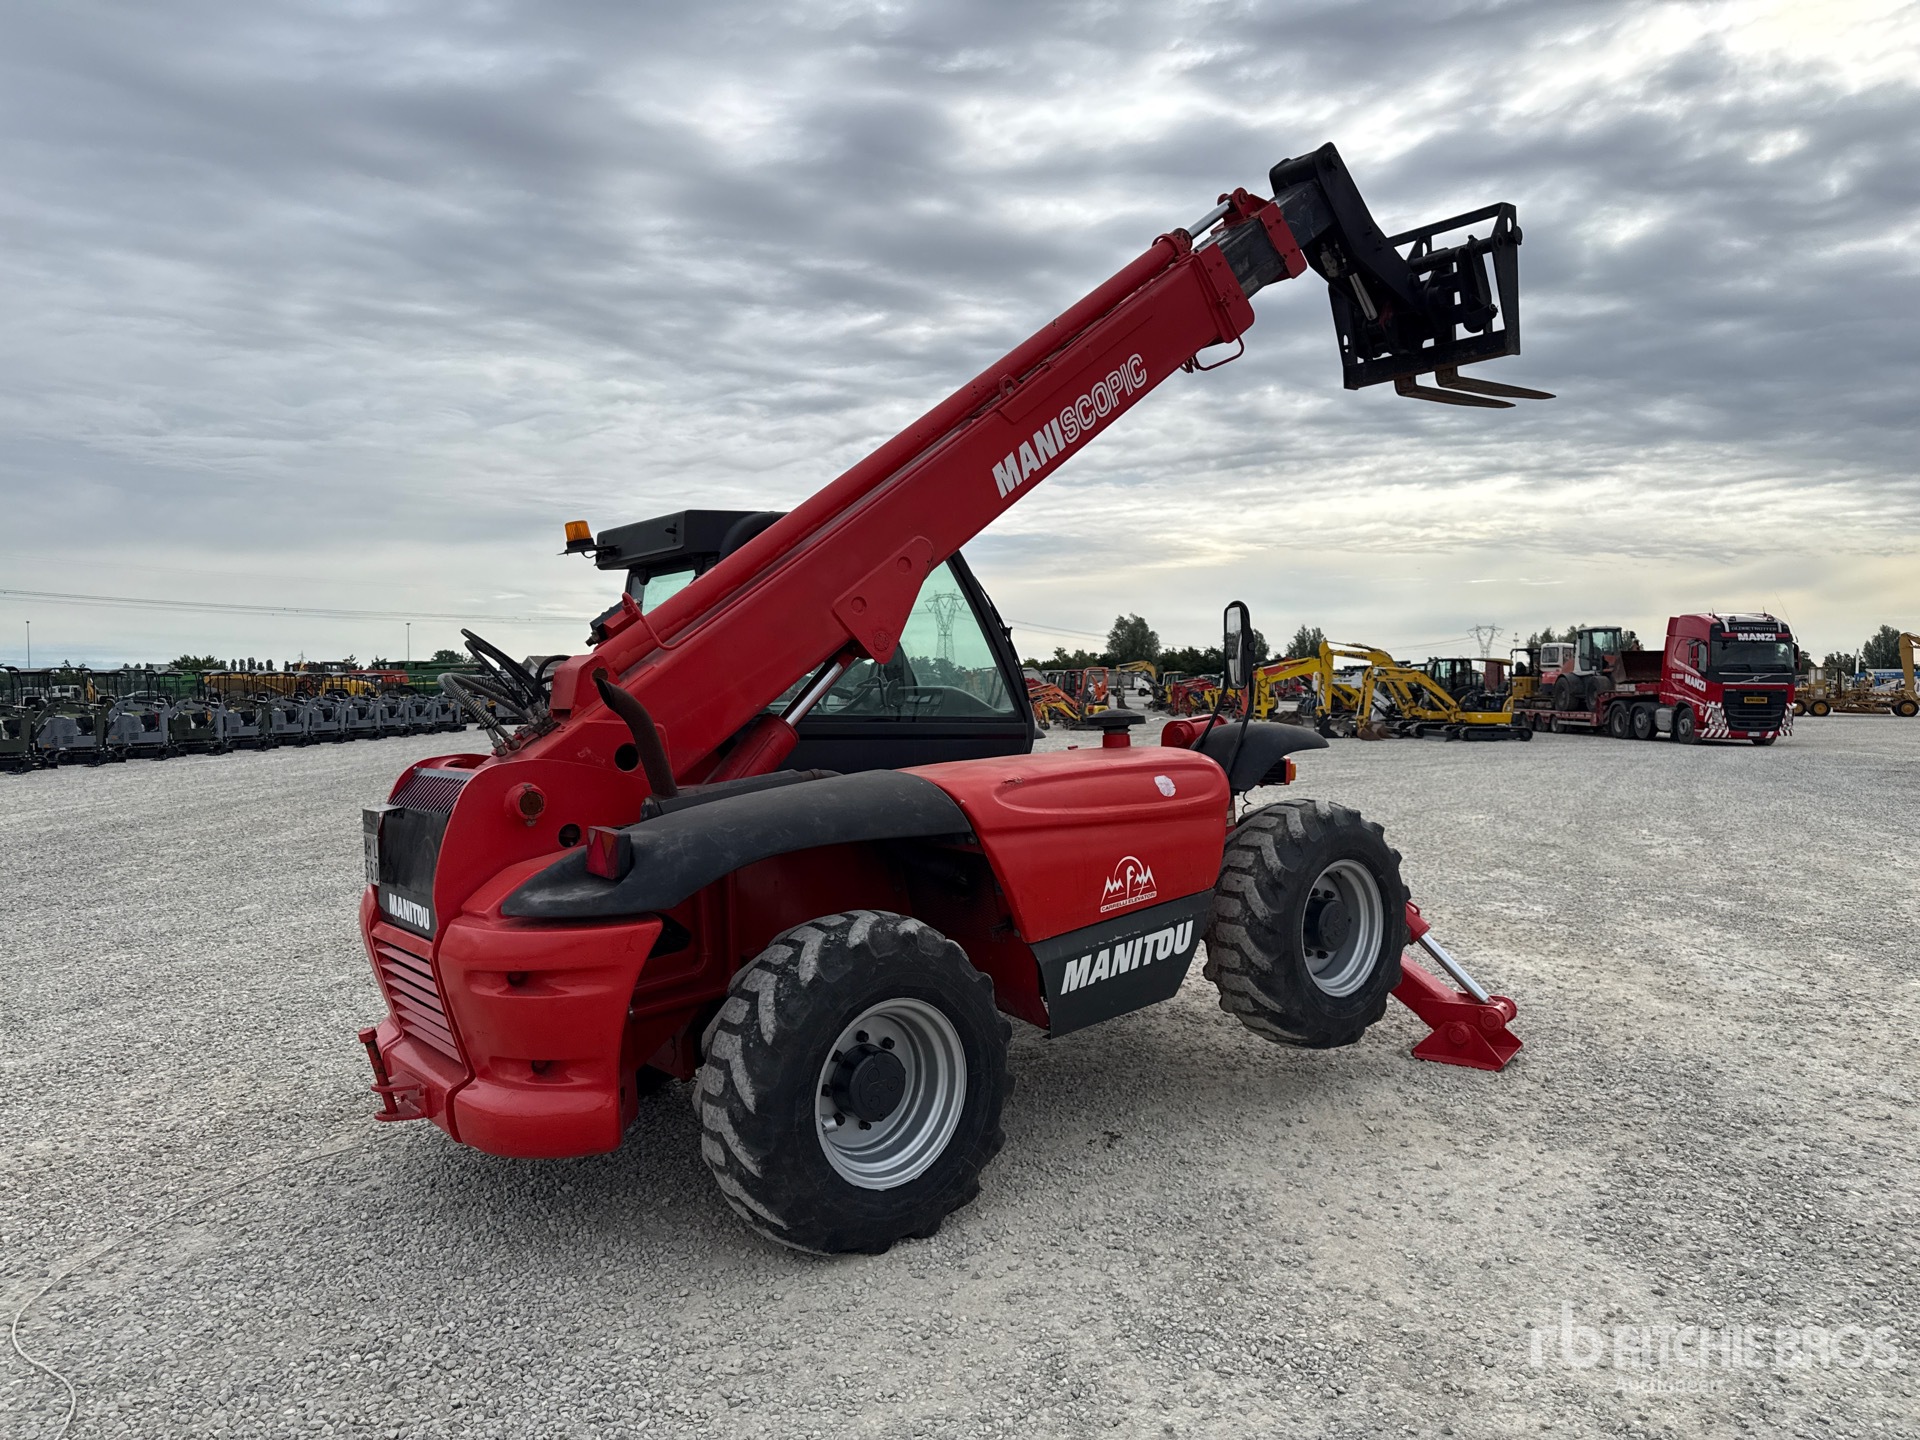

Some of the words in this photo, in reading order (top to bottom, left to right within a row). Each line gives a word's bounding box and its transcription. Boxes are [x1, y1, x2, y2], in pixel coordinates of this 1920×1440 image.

[991, 353, 1147, 499] MANISCOPIC
[1737, 632, 1776, 641] MANZI
[1684, 673, 1706, 692] MANZI
[388, 892, 430, 930] MANITOU
[1060, 920, 1193, 995] MANITOU
